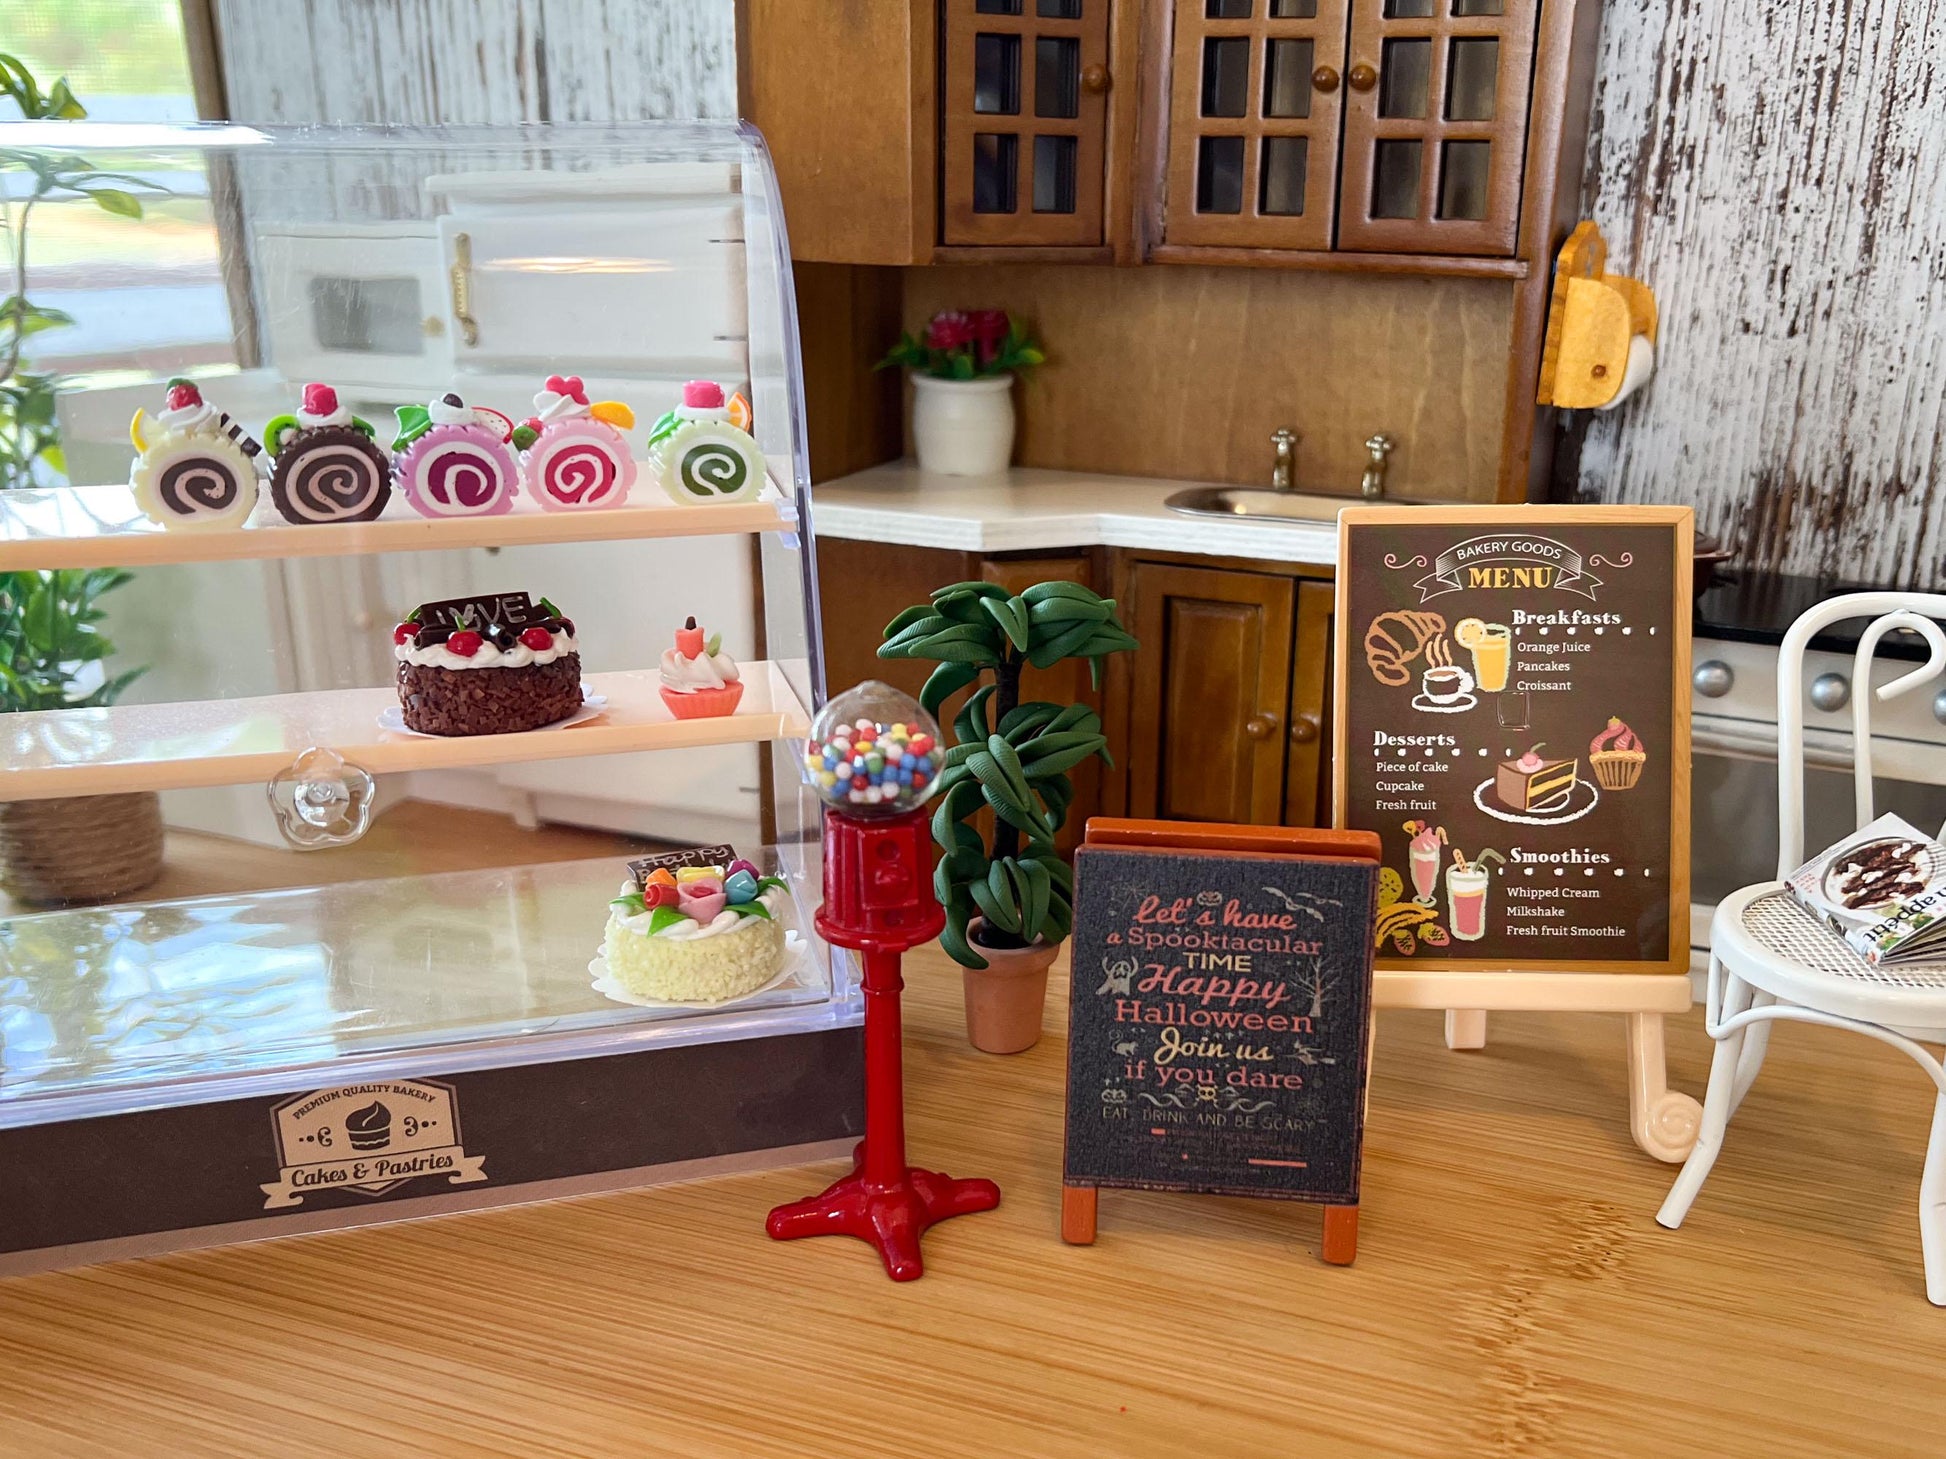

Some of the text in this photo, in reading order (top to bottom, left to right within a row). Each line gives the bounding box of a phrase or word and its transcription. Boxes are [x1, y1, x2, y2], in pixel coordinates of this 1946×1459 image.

[1456, 540, 1562, 561] BAKERY GOODS
[1468, 567, 1553, 589] MENU
[1511, 609, 1622, 626] Breakfasts
[1517, 641, 1591, 654] Orange Juice
[1517, 660, 1571, 673] Pancakes
[1517, 679, 1572, 691] Croissant
[1373, 730, 1456, 746] Desserts
[1376, 761, 1449, 773] Piece of cake
[1376, 780, 1425, 793] Cupcake
[1375, 799, 1437, 811] Fresh fruit
[638, 846, 730, 867] Happy
[1510, 847, 1611, 864] Smoothies
[1506, 887, 1600, 900] Whipped Cream
[1222, 899, 1298, 930] have
[1506, 905, 1565, 918] Milkshake
[1863, 895, 1938, 943] appétit
[1106, 927, 1324, 956] a Spooktacular
[1506, 925, 1626, 938] Fresh fruit Smoothie
[1183, 951, 1252, 973] TIME
[1138, 963, 1292, 1009] Happy
[1114, 999, 1314, 1034] Halloween
[1154, 1027, 1274, 1066] Join us
[1125, 1059, 1304, 1090] if you dare
[292, 1084, 437, 1120] PREMIUM QUALITY BAKERY
[1142, 1108, 1189, 1124] DRINK
[1196, 1112, 1227, 1127] AND
[1234, 1114, 1255, 1129] BE
[1262, 1115, 1316, 1132] SCARY
[291, 1153, 454, 1188] Cakes & Pastries
